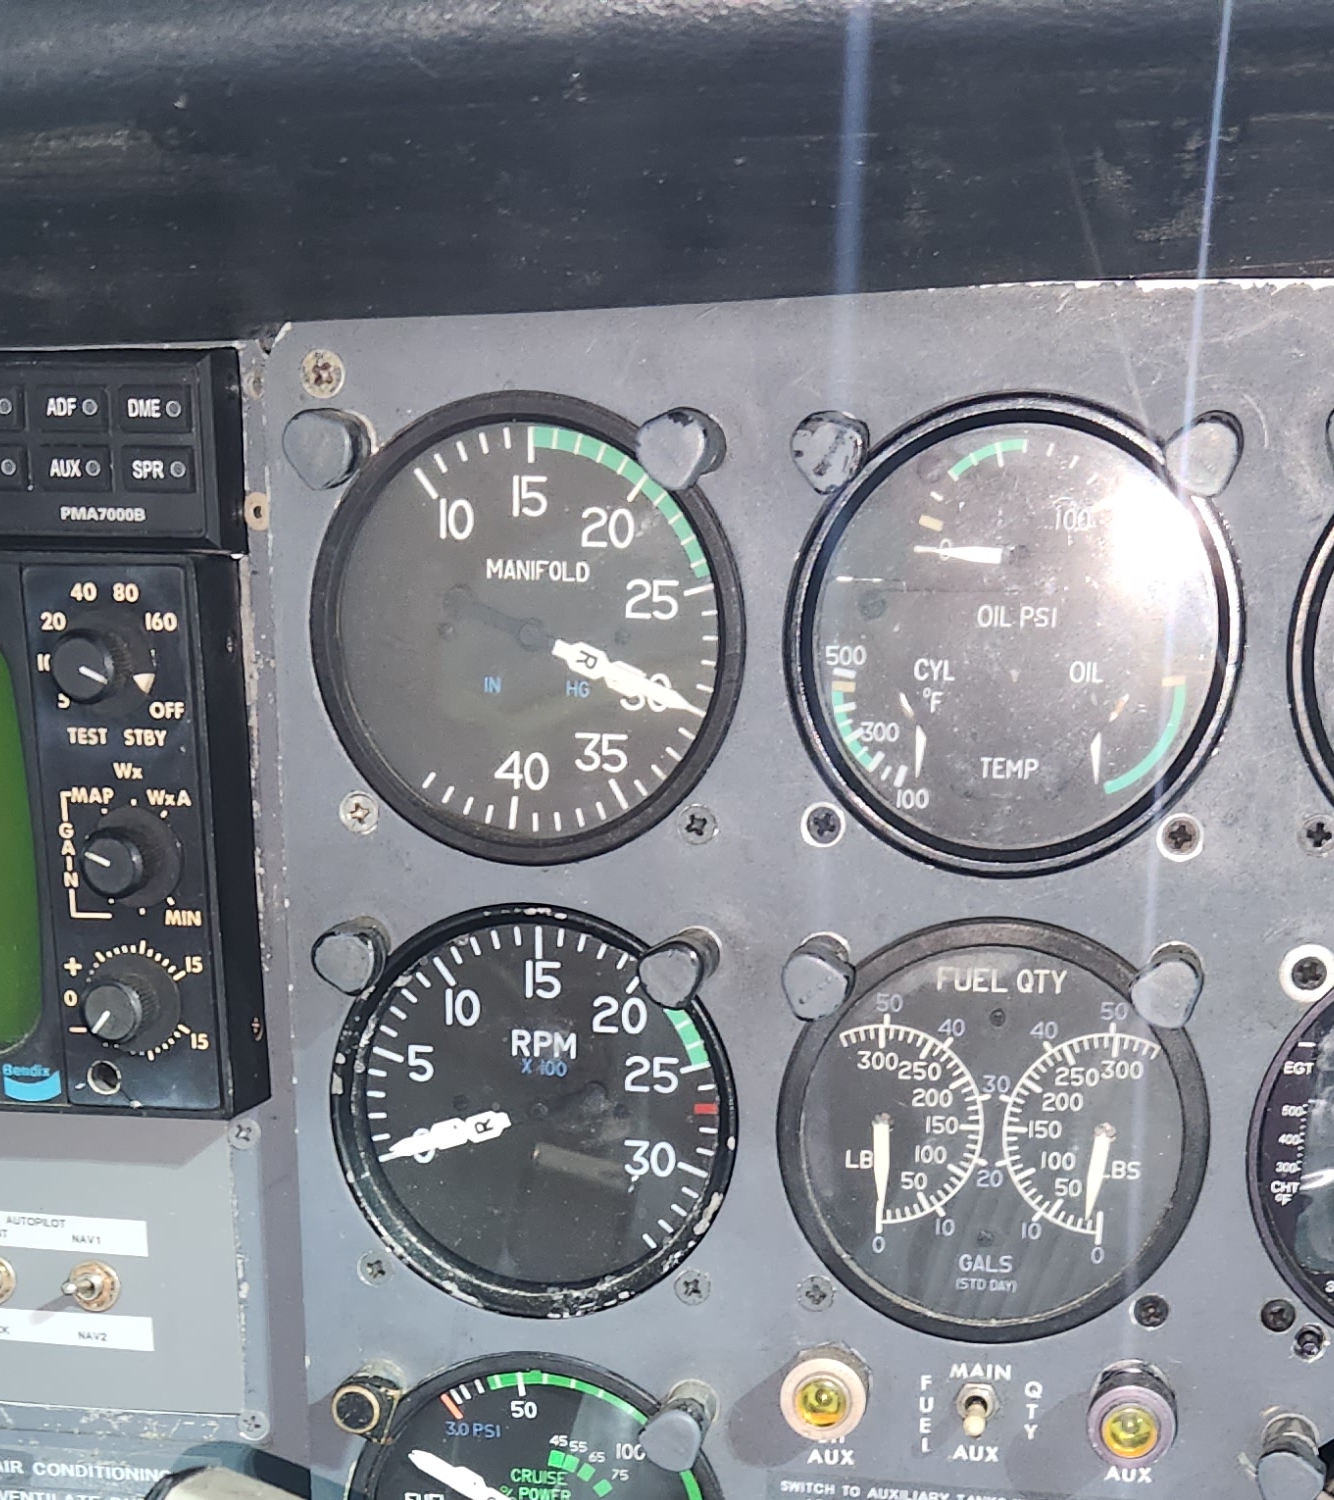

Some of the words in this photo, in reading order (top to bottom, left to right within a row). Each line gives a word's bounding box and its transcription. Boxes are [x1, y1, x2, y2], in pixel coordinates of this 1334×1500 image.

[47, 399, 76, 416] ADF
[128, 399, 161, 417] DME
[50, 459, 81, 477] AUX
[133, 461, 163, 479] SPR
[512, 476, 547, 517] 15
[61, 508, 146, 521] PMA7000B
[440, 498, 474, 540] 10
[581, 507, 634, 548] 20
[486, 559, 590, 582] MANIFOLD
[70, 583, 97, 601] 40
[113, 583, 139, 603] 80
[626, 580, 679, 619] 25
[40, 612, 66, 630] 20
[145, 612, 177, 631] 160
[978, 606, 1011, 627] OIL
[1021, 608, 1057, 628] PSI
[914, 659, 955, 682] CYL
[1070, 661, 1103, 684] OIL
[149, 702, 185, 719] OFF
[68, 728, 107, 744] TEST
[124, 729, 167, 746] STBY
[575, 733, 628, 772] 35
[494, 751, 549, 790] 40
[981, 758, 1038, 781] TEMP
[71, 787, 114, 804] MAP
[165, 910, 202, 926] MIN
[525, 961, 561, 998] 15
[937, 967, 1008, 993] FUEL
[1017, 970, 1067, 993] QTY
[445, 990, 480, 1027] 10
[593, 997, 647, 1034] 20
[191, 1034, 209, 1049] 15
[511, 1030, 576, 1060] RPM
[408, 1045, 434, 1082] 5
[1284, 1063, 1313, 1075] EGT
[625, 1058, 678, 1093] 25
[624, 1140, 675, 1177] 30
[7, 1216, 65, 1229] AUTOPILOT
[72, 1234, 101, 1245] NAV1
[959, 1255, 1013, 1274] GALS
[79, 1331, 108, 1341] NAV2
[949, 1364, 1011, 1380] MAIN
[511, 1402, 537, 1418] 50
[446, 1423, 470, 1436] 3.0
[473, 1424, 500, 1437] PSI
[808, 1450, 855, 1466] AUX
[953, 1446, 998, 1463] AUX
[32, 1462, 172, 1482] CONDITIONING
[511, 1469, 567, 1486] CRUISE
[1105, 1467, 1153, 1483] AUX
[781, 1480, 835, 1496] SWITCH
[842, 1485, 859, 1497] TO
